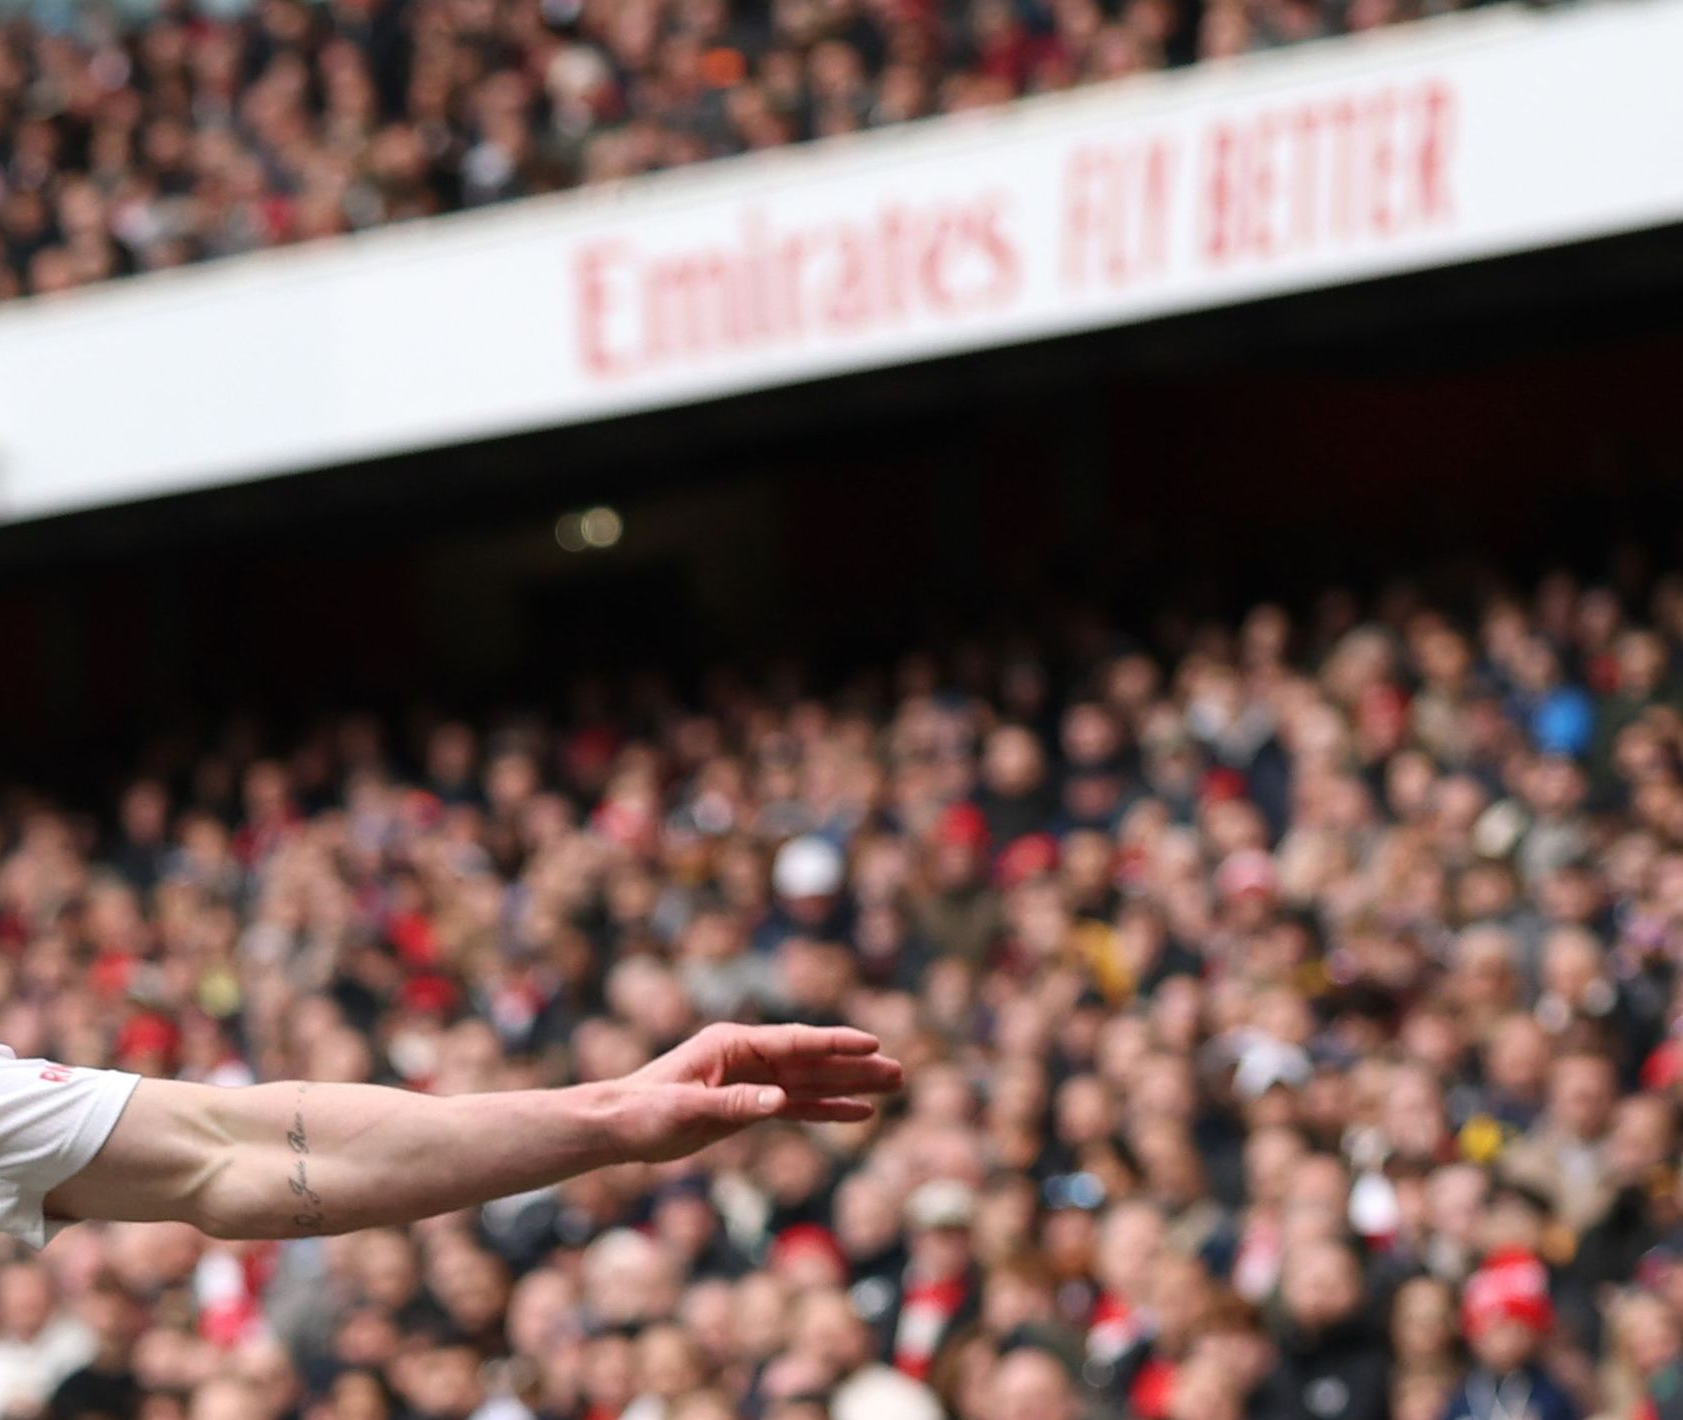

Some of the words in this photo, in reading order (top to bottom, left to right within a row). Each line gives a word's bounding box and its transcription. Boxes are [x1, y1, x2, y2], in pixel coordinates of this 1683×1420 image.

[573, 198, 1023, 380] Emirates
[1059, 140, 1175, 290] FLY
[1199, 78, 1457, 268] BETTER
